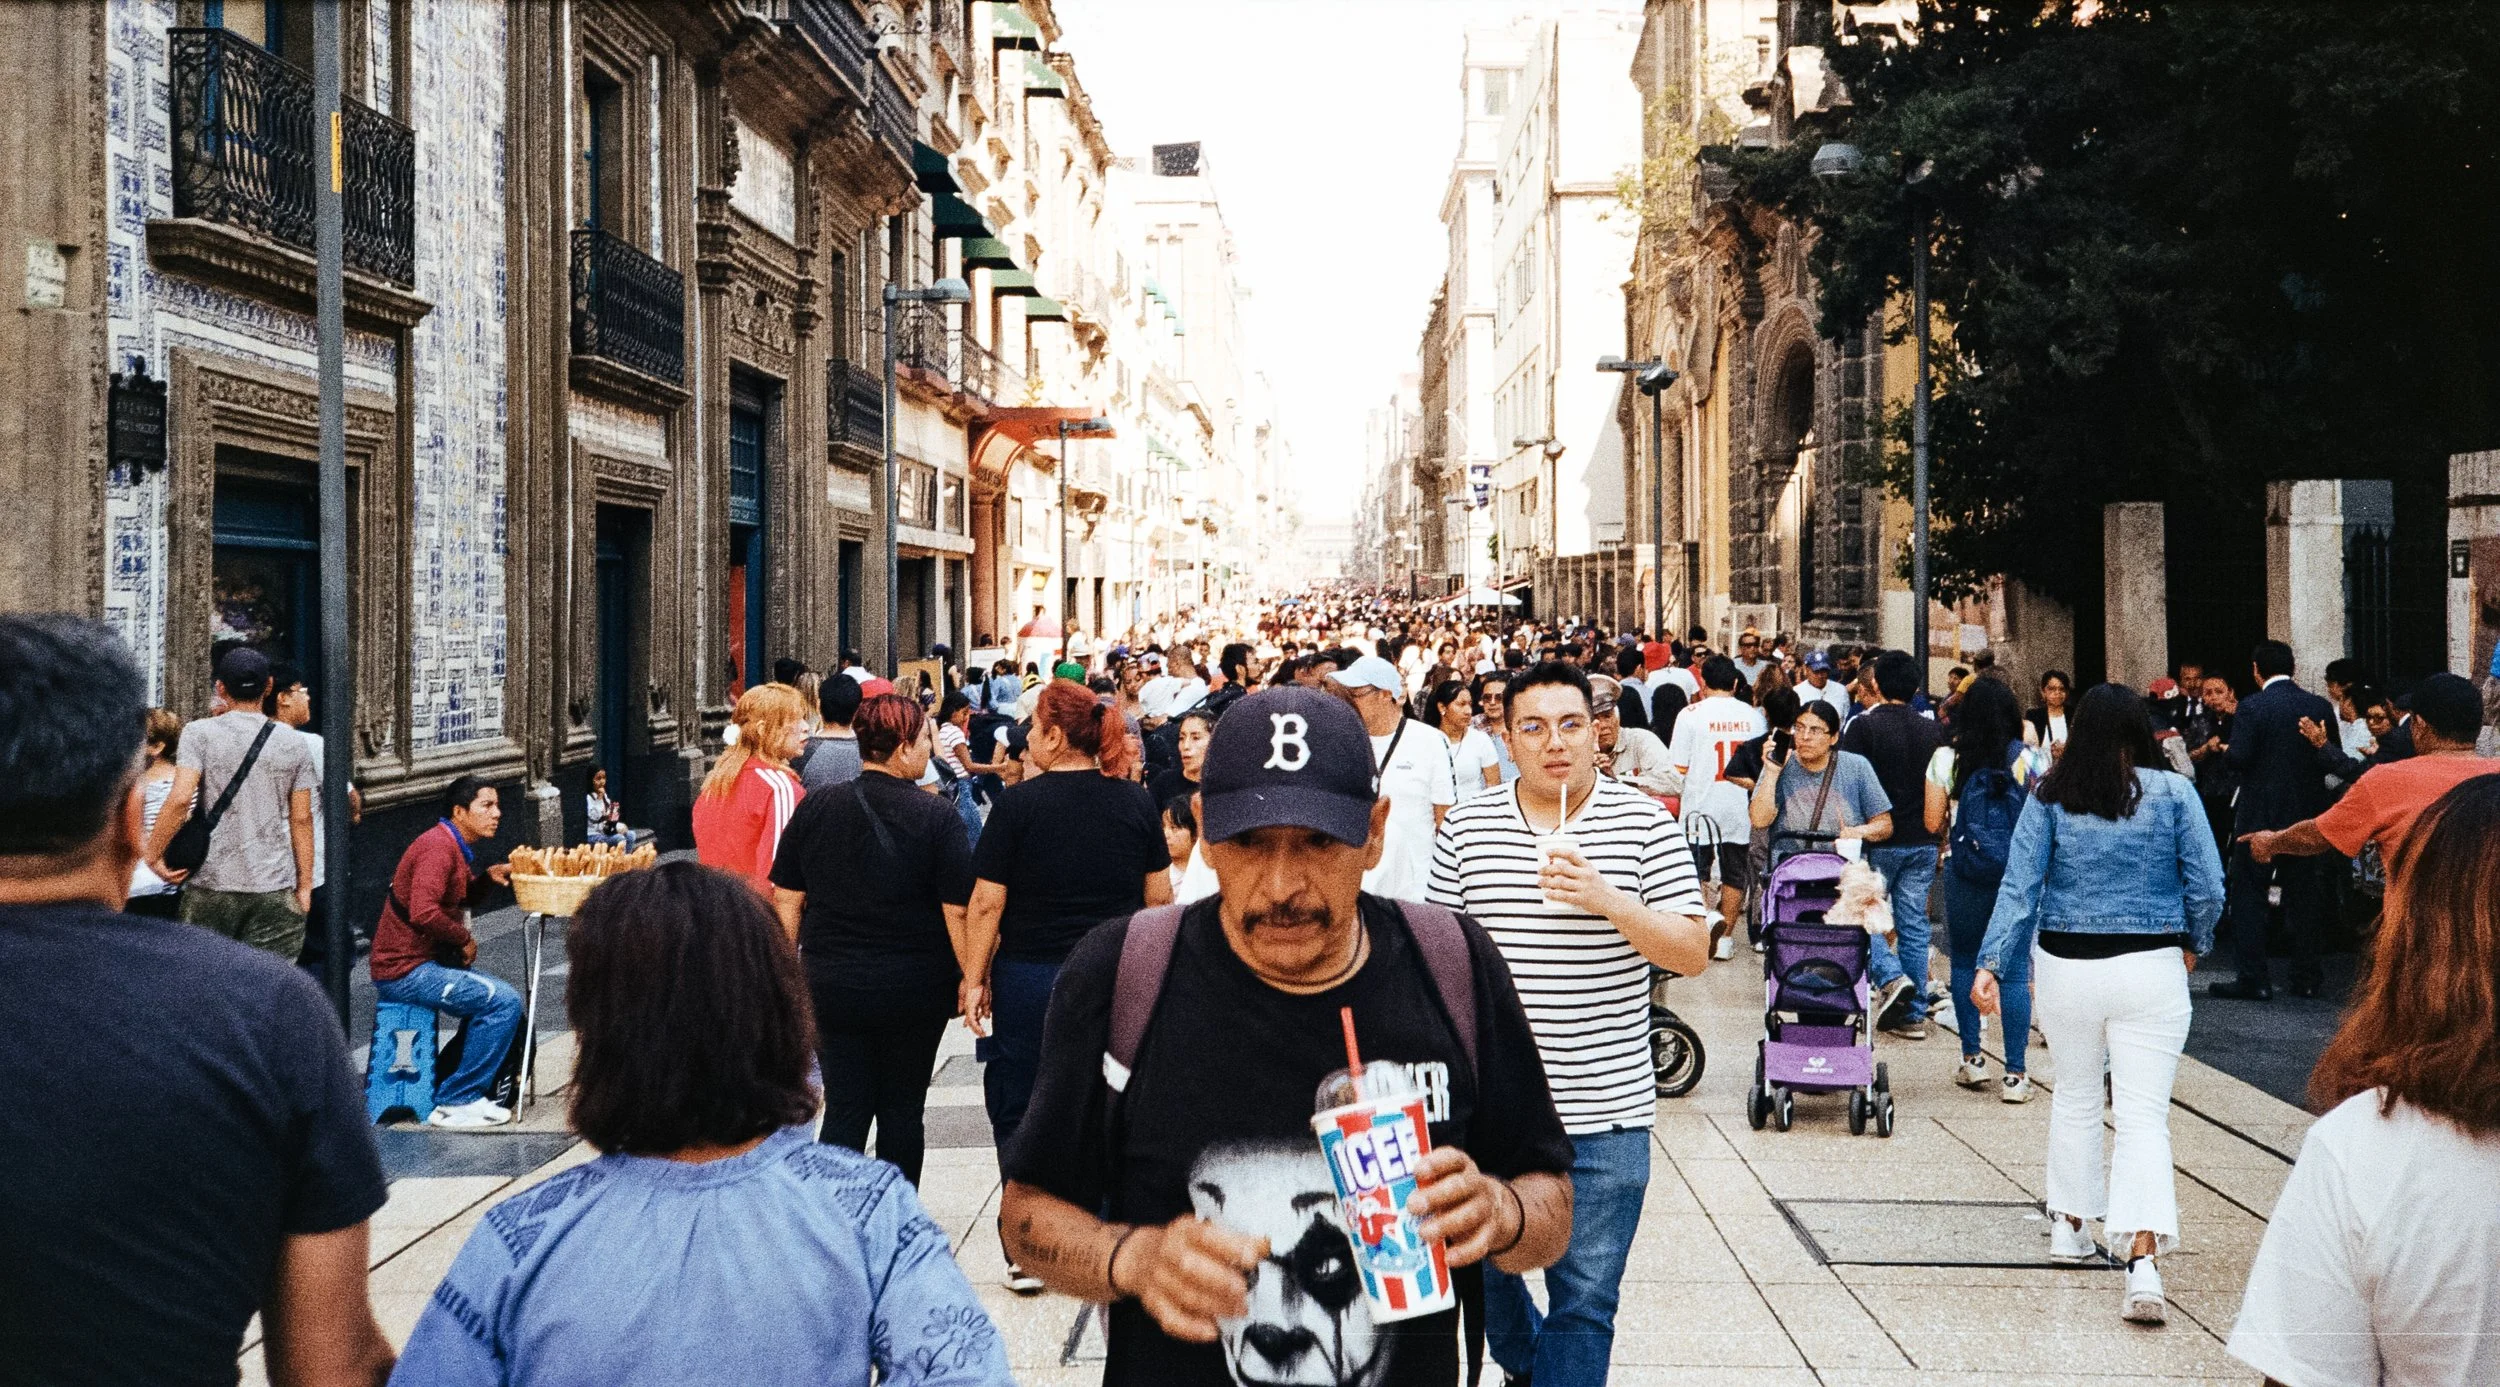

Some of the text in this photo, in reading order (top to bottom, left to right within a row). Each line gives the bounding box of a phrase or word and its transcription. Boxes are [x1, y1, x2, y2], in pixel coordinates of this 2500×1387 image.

[1263, 713, 1311, 771] B
[1709, 721, 1751, 732] MAHOMES
[1332, 1117, 1420, 1196] ICEE
